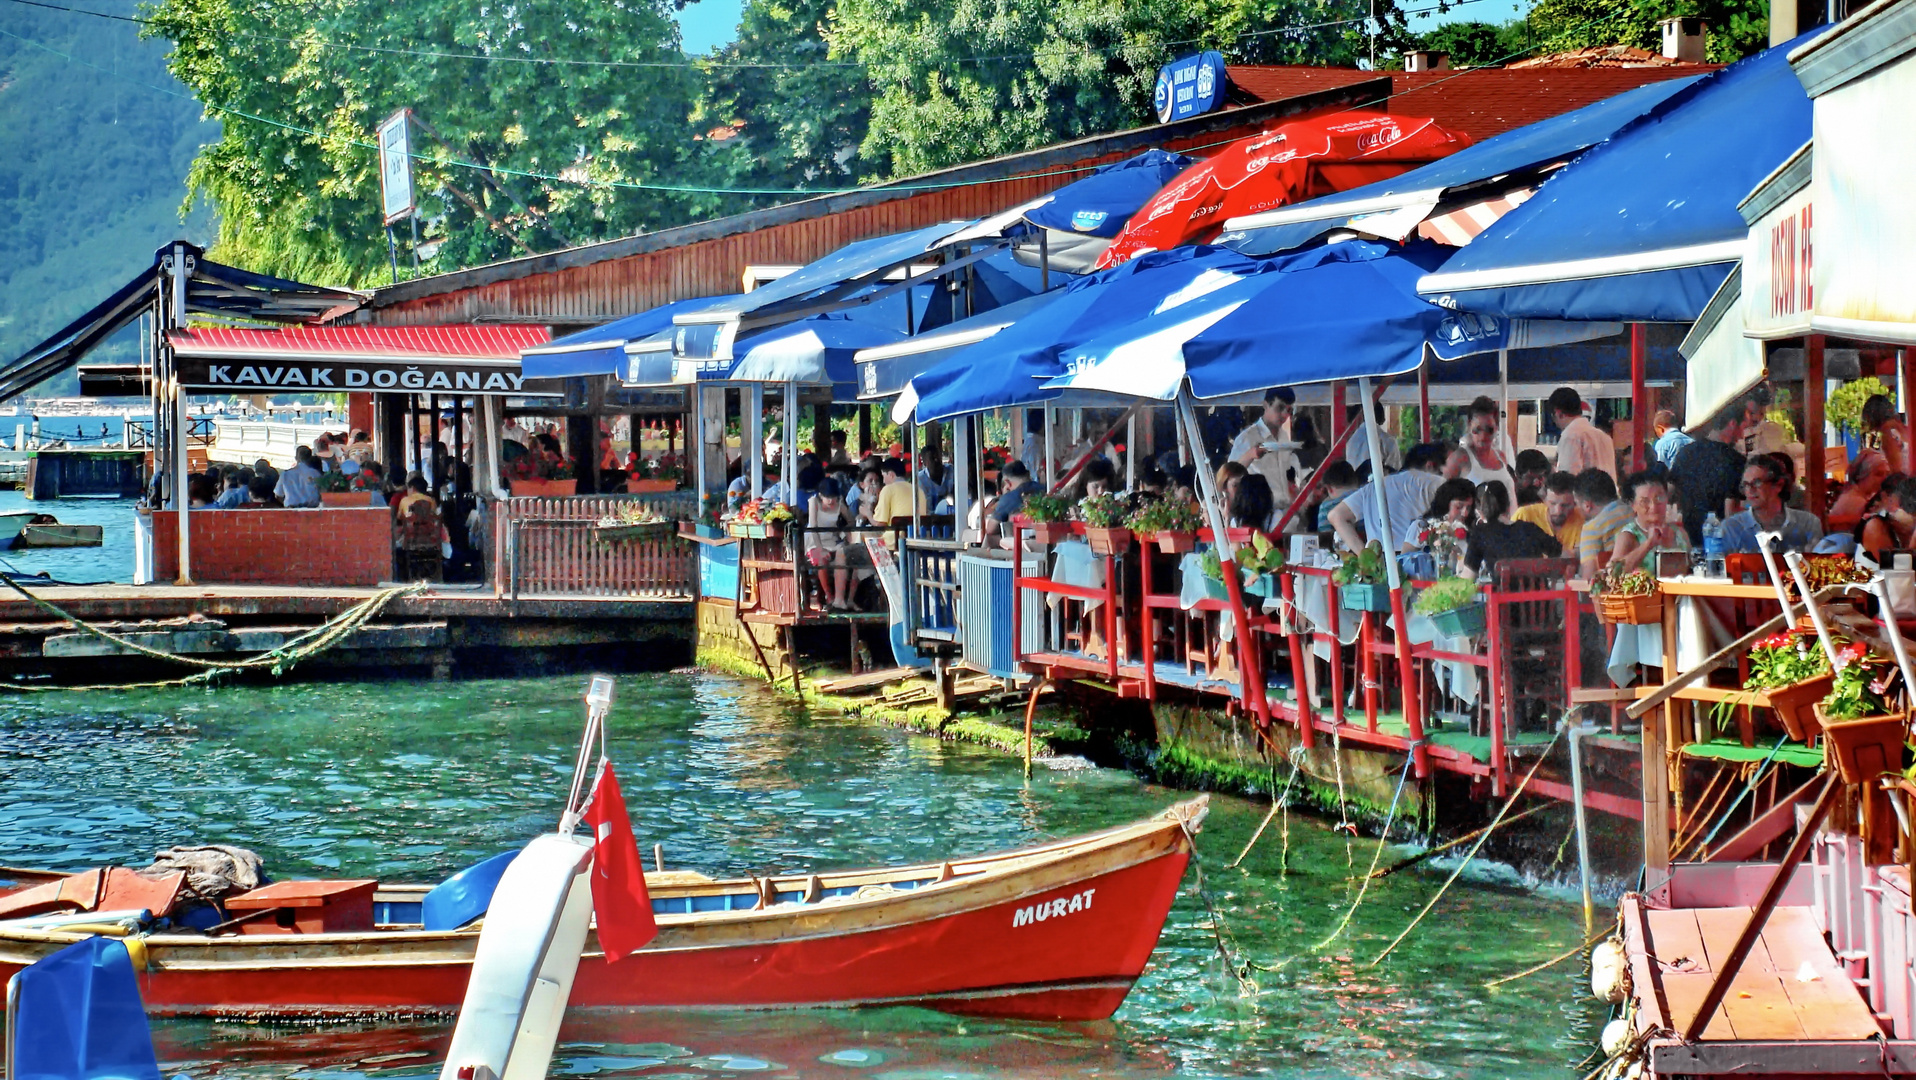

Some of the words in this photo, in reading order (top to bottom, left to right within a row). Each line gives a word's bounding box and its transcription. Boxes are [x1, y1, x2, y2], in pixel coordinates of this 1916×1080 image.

[208, 364, 335, 387] KAVAK
[345, 365, 526, 391] DOĞANAY
[1012, 888, 1096, 928] MURAT
